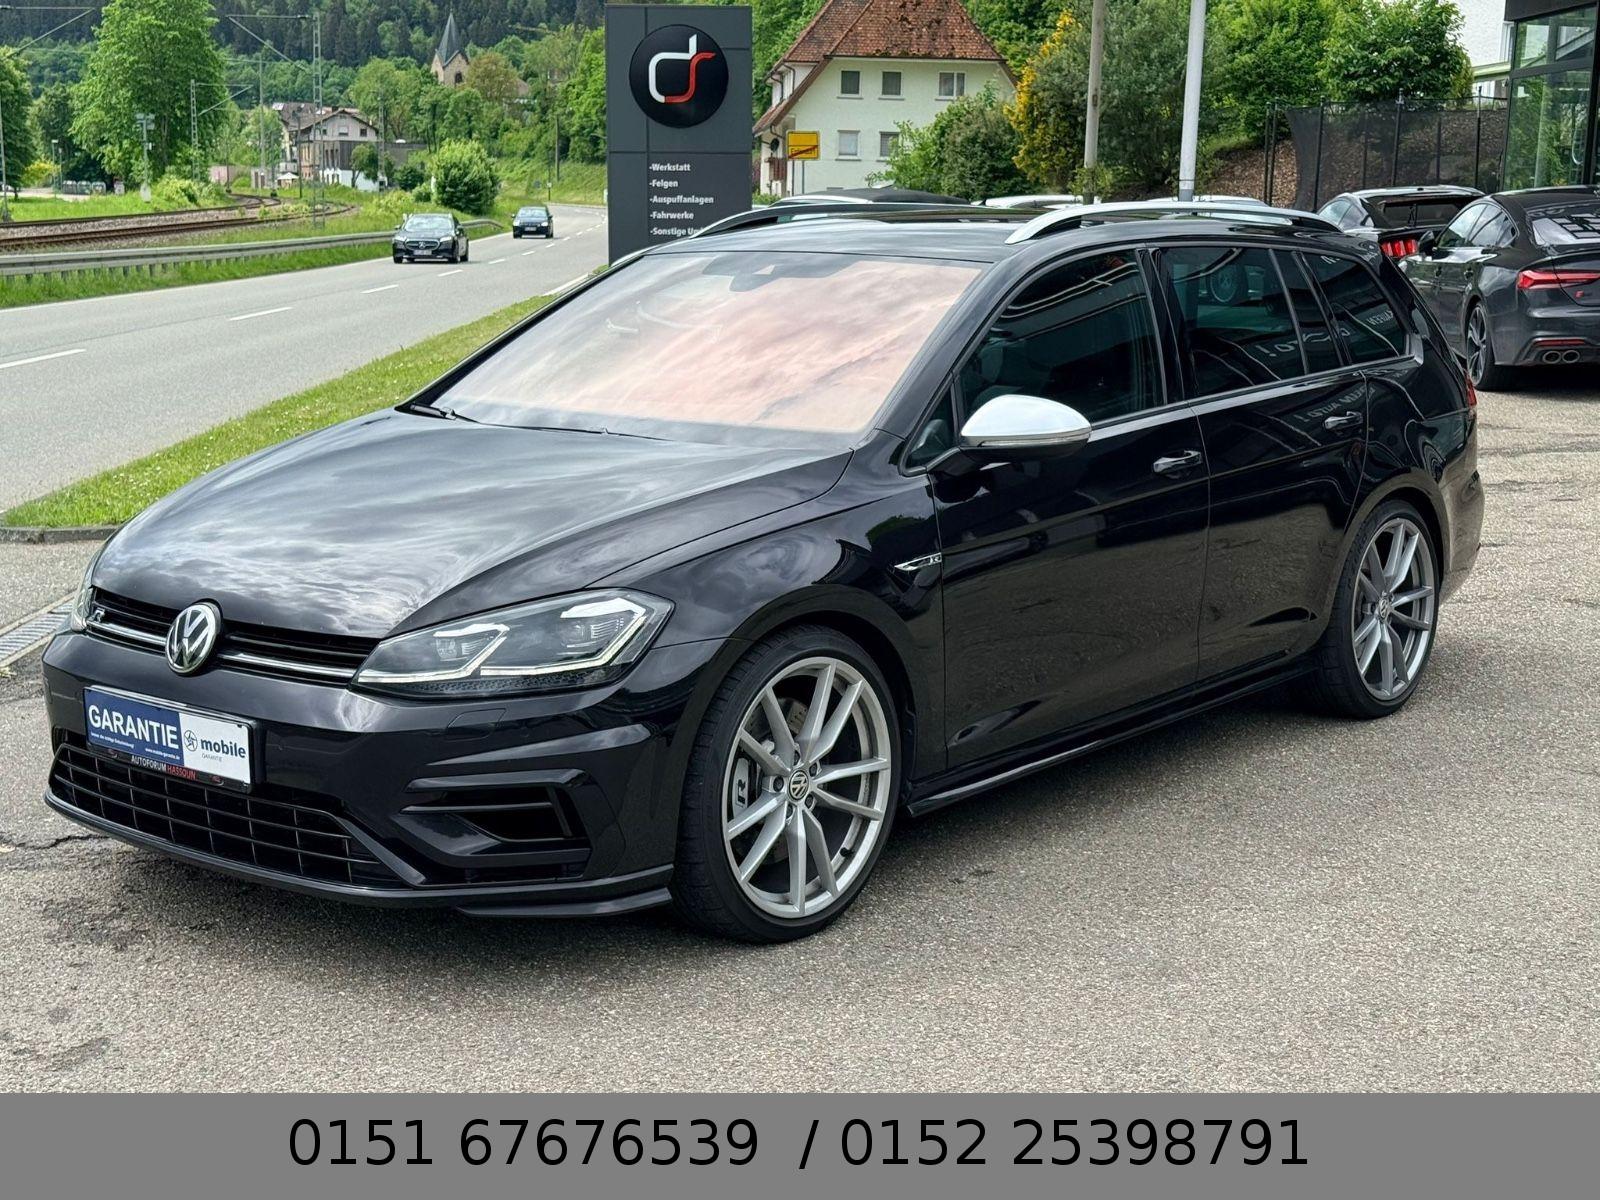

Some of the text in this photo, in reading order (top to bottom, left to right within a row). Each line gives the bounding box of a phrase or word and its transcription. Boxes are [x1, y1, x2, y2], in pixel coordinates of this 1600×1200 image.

[649, 163, 691, 171] -Werkstatt
[649, 179, 679, 189] -Felgen
[649, 195, 714, 205] -Auspuffanlagen
[650, 211, 694, 220] -Fahrwerke
[650, 227, 687, 237] -Sonstige
[88, 704, 179, 749] GARANTIE
[200, 739, 247, 758] mobile
[131, 755, 196, 779] AUTOFORUM HASSOUN
